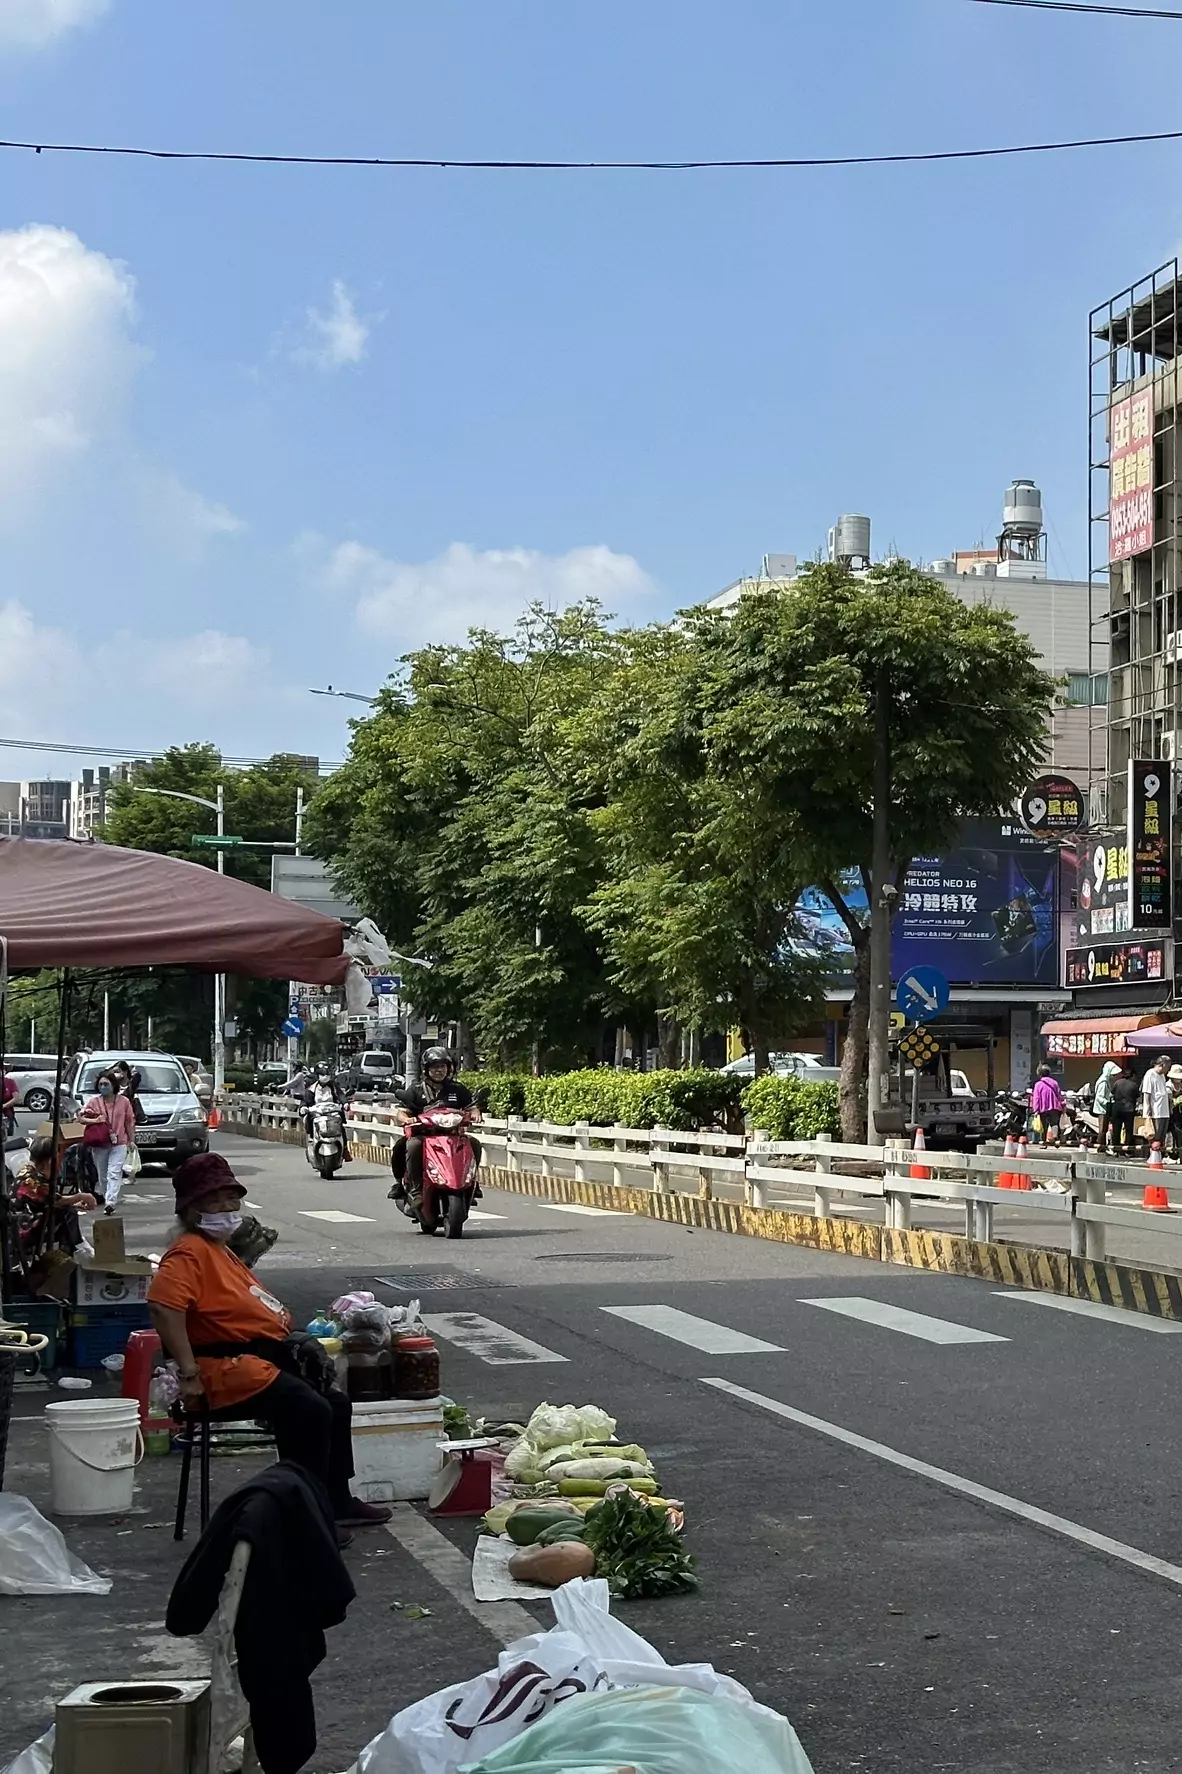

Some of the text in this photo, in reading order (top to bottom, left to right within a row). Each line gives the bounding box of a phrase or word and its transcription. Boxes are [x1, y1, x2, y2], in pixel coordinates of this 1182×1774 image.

[904, 879, 977, 888] HELIOS NEO 16
[291, 997, 299, 1005] P
